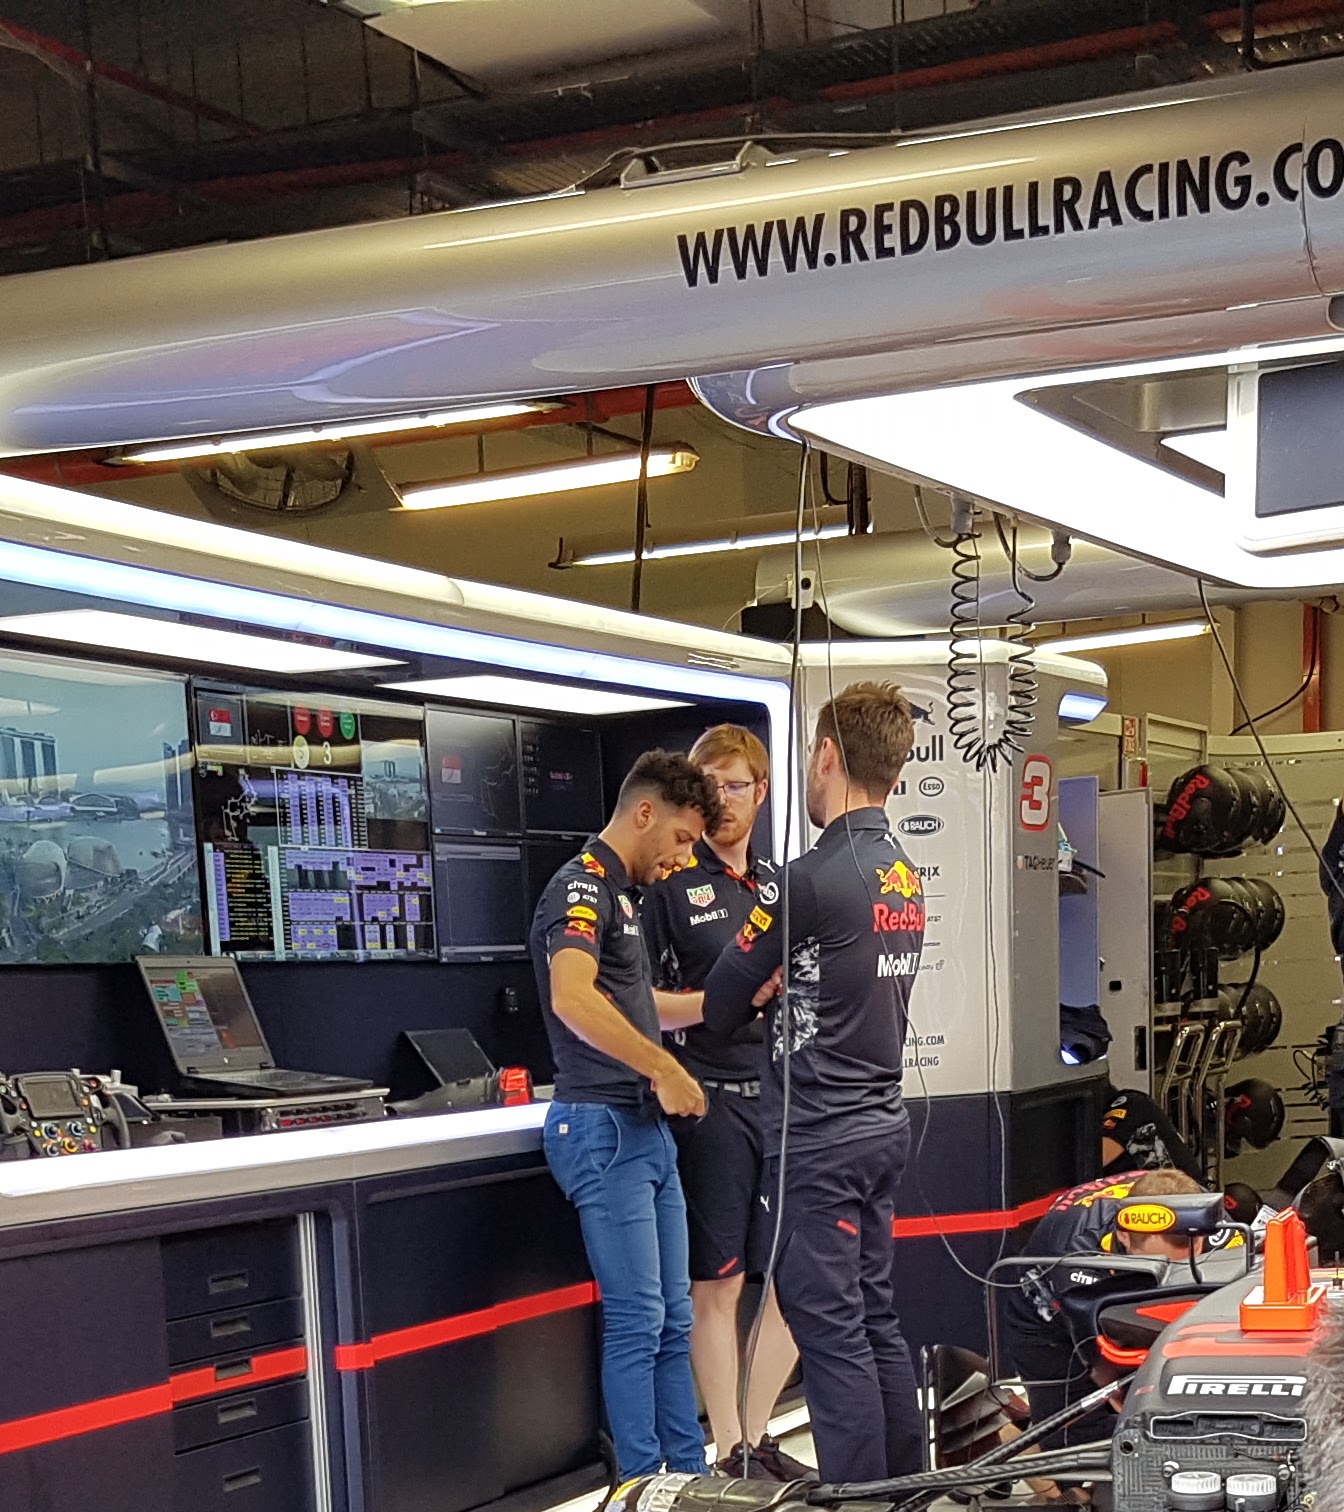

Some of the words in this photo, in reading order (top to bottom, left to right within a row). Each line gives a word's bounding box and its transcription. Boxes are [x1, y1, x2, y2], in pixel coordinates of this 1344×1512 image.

[1019, 754, 1052, 832] 3
[910, 818, 938, 832] RAUCH
[1131, 1212, 1166, 1224] RAUCH
[1167, 1375, 1307, 1397] PIRELLI
